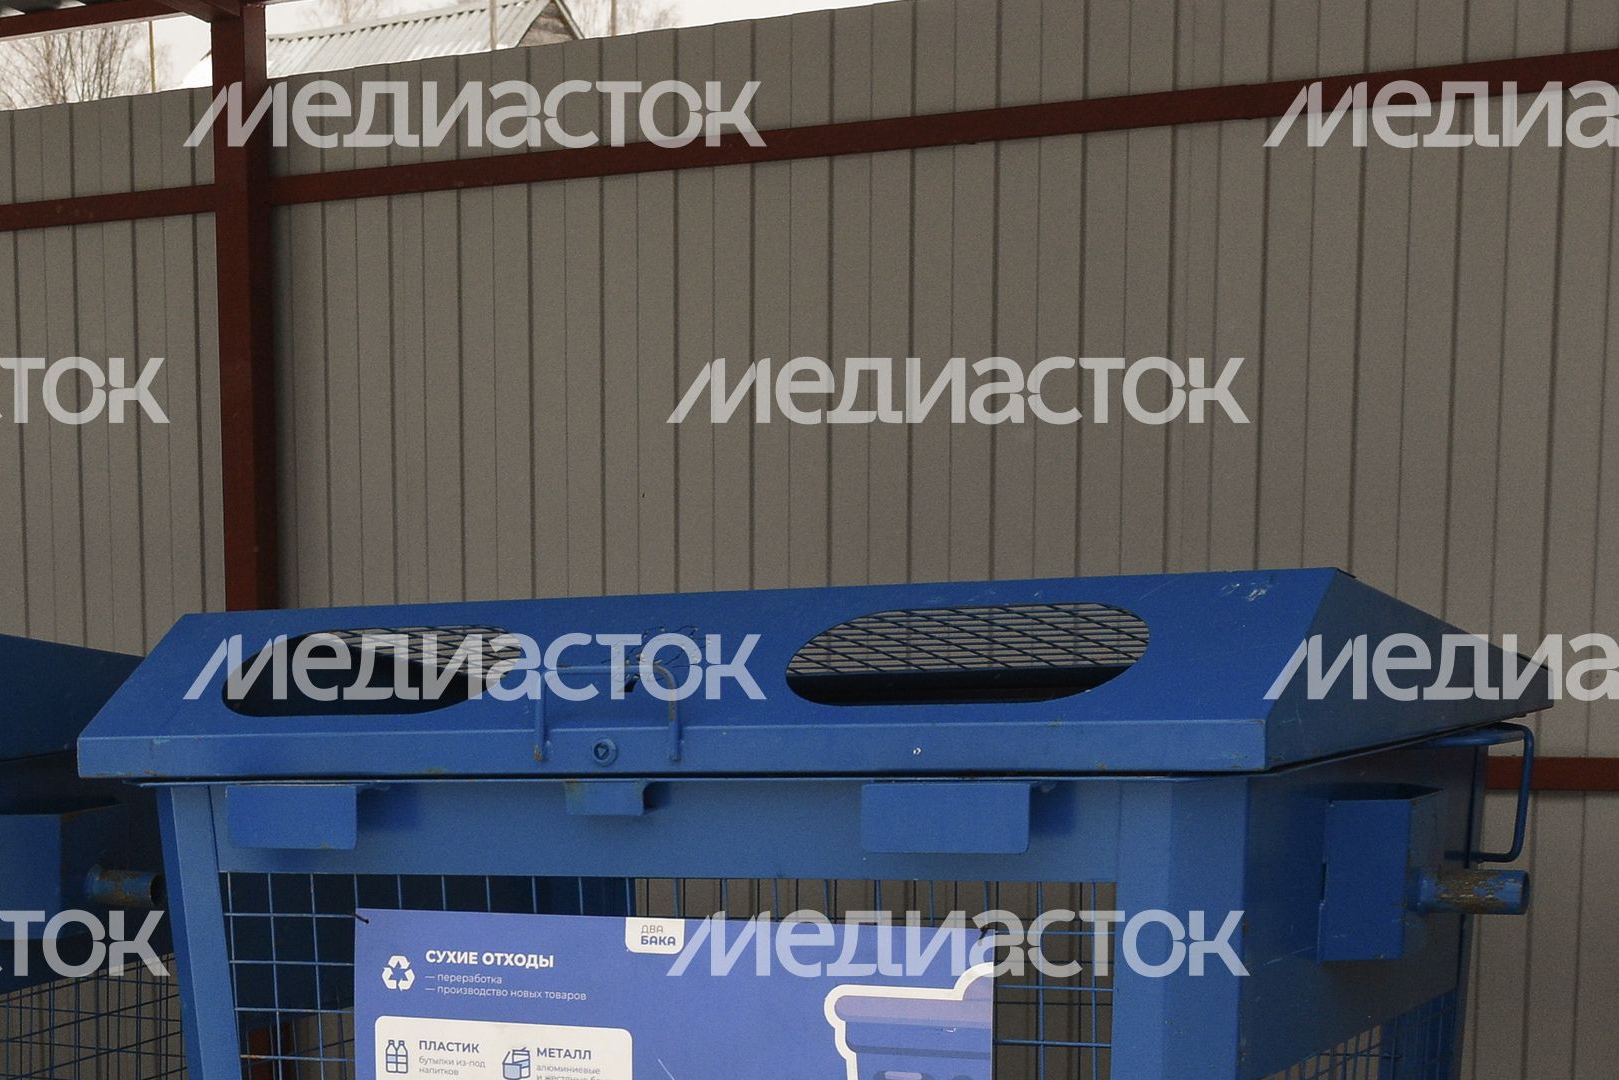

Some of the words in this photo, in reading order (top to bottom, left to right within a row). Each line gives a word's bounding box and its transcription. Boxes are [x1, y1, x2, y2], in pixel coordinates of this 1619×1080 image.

[641, 925, 664, 934] ДВА
[640, 935, 677, 946] БАКА
[425, 950, 478, 965] СУХИЕ
[482, 952, 554, 969] ОТХОДЫ
[437, 972, 503, 985] переработка
[437, 985, 508, 998] производство
[510, 990, 542, 999] новых
[545, 991, 587, 1001] товаров
[419, 1040, 480, 1054] ПЛАСТИК
[536, 1048, 592, 1060] МЕТАЛЛ
[419, 1055, 454, 1067] бутылки
[456, 1059, 486, 1069] из-под
[419, 1067, 459, 1076] напитков
[536, 1065, 601, 1075] алюминиевые
